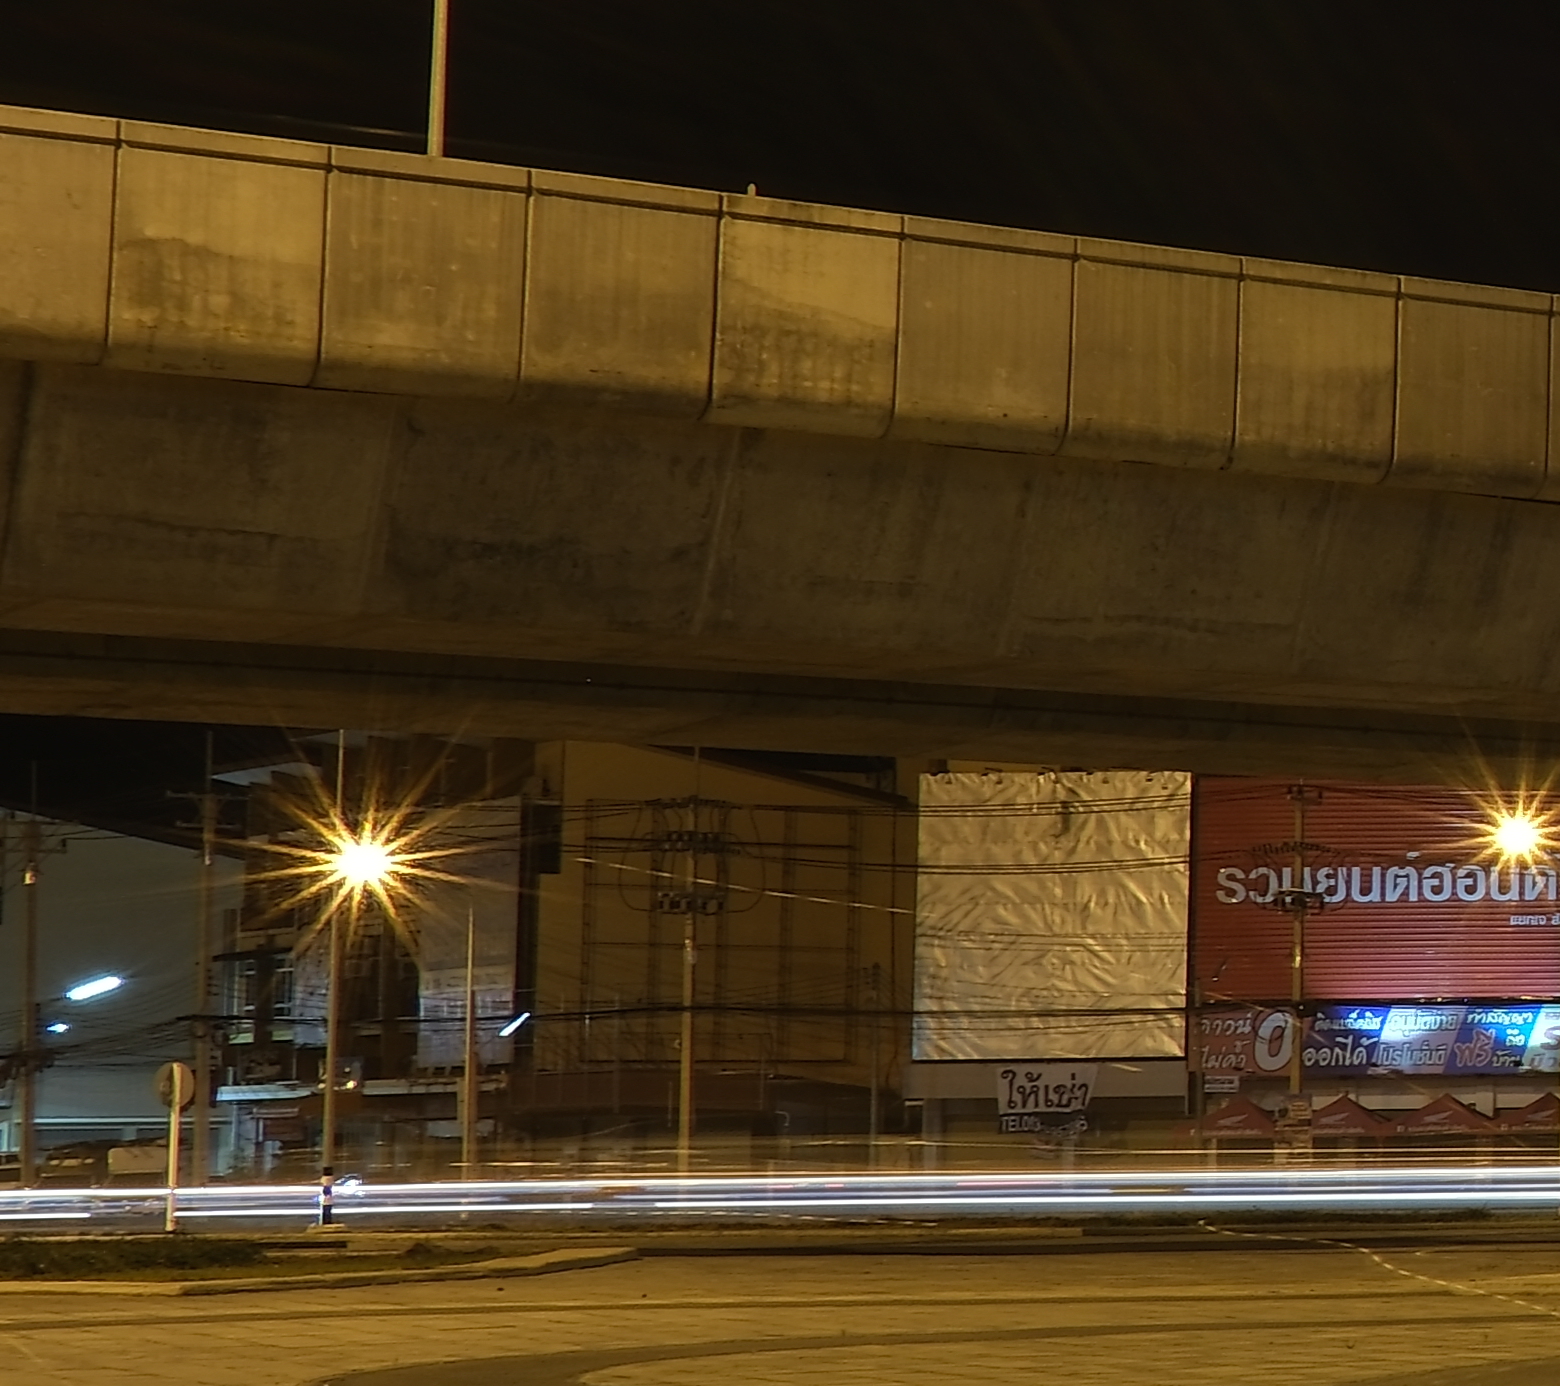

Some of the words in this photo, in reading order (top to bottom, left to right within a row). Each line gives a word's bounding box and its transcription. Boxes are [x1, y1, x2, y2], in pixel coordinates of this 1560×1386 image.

[1255, 1011, 1295, 1072] 0
[1302, 1035, 1379, 1067] ออกได้
[1001, 1069, 1089, 1109] ให้เช่า
